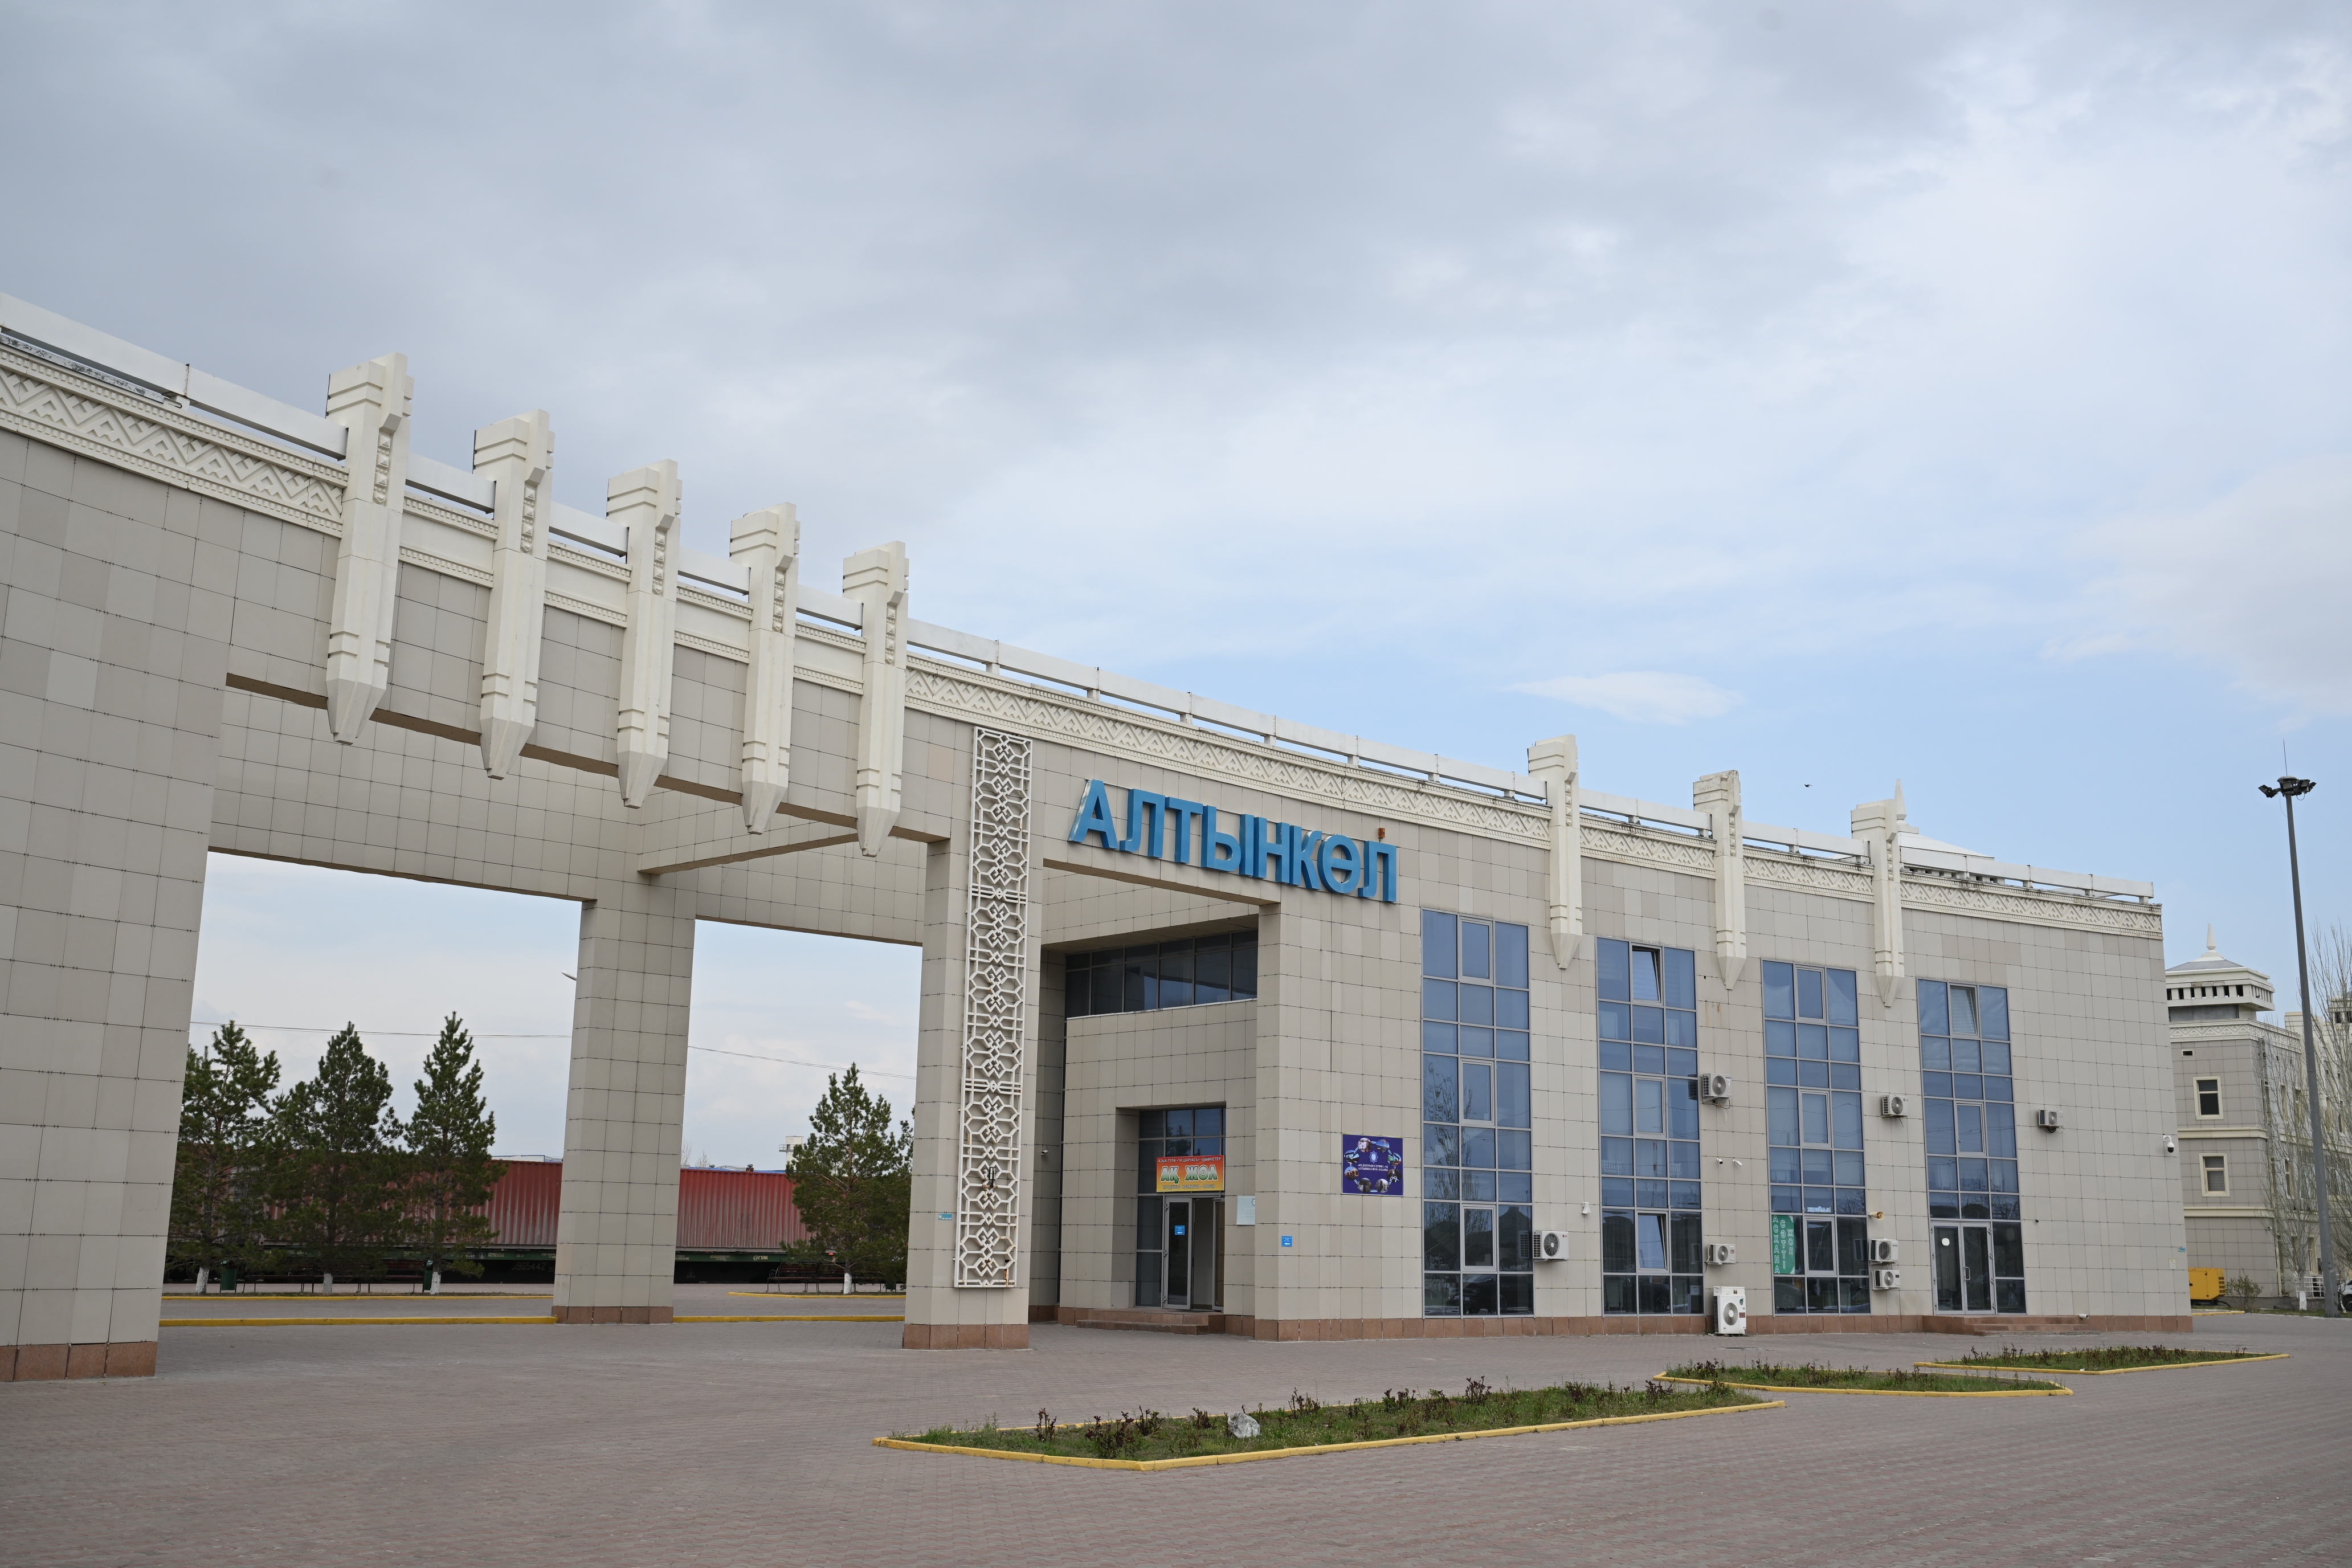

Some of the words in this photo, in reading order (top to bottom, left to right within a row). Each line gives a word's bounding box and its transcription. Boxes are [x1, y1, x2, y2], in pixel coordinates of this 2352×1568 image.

[1068, 779, 1397, 903] АЛТЫНКӨЛ
[1161, 1166, 1179, 1184] АҚ
[1185, 1165, 1218, 1182] ЖОЛ
